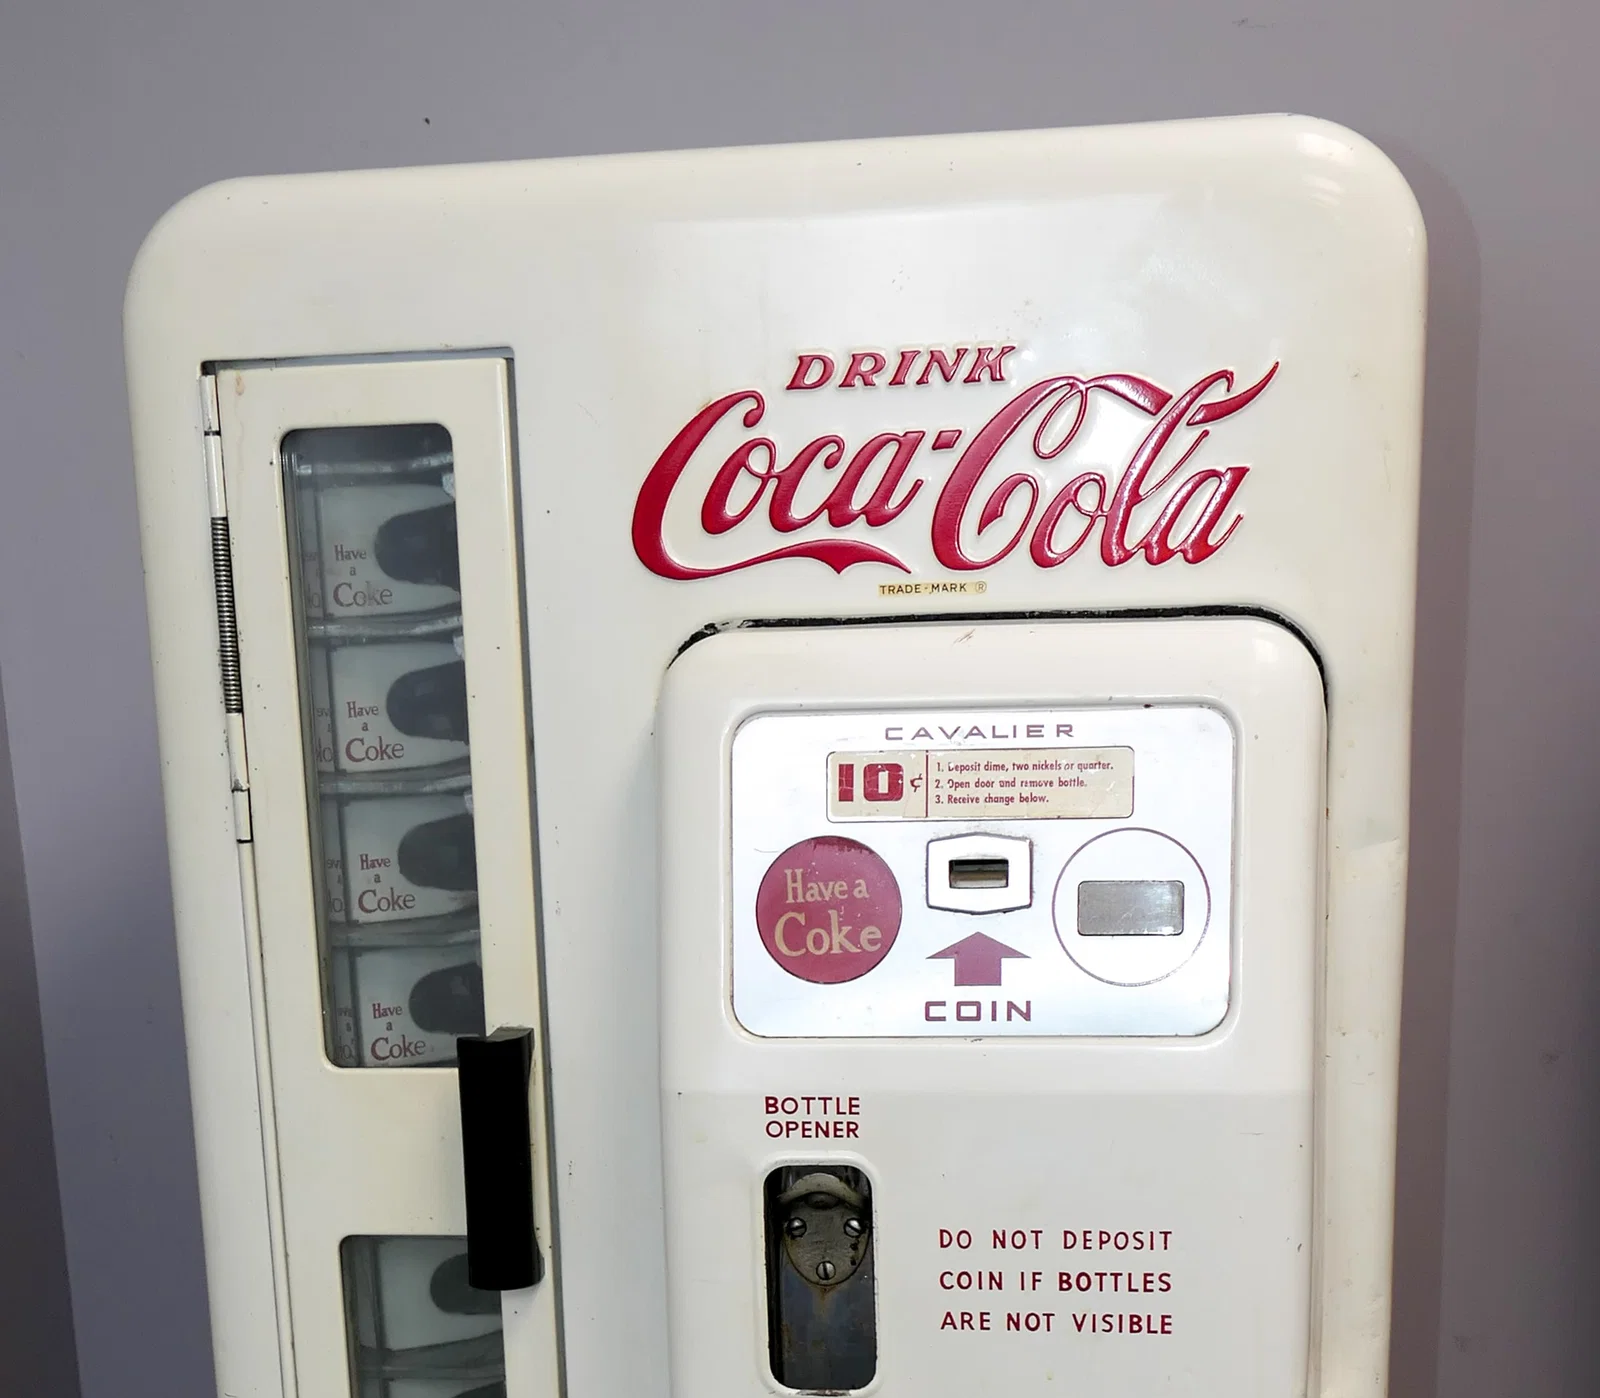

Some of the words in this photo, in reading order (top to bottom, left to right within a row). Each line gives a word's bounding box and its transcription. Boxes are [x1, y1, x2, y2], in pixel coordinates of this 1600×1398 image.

[786, 345, 1017, 391] DRINK
[632, 360, 1280, 581] Coca-Cola
[334, 544, 367, 562] Have
[349, 566, 357, 577] a
[332, 580, 393, 607] Coke
[346, 700, 379, 719] Have
[361, 721, 369, 732] a
[885, 724, 1074, 741] CAVALIER
[345, 736, 405, 763] Coke
[936, 762, 944, 773] 1.
[984, 761, 1009, 772] dime,
[1012, 762, 1030, 771] two
[1032, 760, 1062, 770] nickels
[1064, 763, 1075, 771] or
[1077, 761, 1114, 772] quarter.
[935, 779, 944, 789] 2.
[947, 779, 971, 791] Open
[975, 777, 995, 788] door
[999, 777, 1016, 788] and
[1020, 779, 1054, 788] remove
[1058, 776, 1087, 788] bottle.
[935, 795, 944, 804] 3.
[947, 794, 980, 804] Receive
[984, 793, 1015, 806] change
[1019, 792, 1049, 803] below.
[359, 853, 391, 870] Have
[373, 873, 381, 884] a
[784, 868, 849, 905] Have
[853, 878, 870, 901] a
[358, 887, 416, 914] Coke
[774, 909, 883, 957] Coke
[372, 1002, 403, 1020] Have
[924, 1000, 1032, 1022] COIN
[386, 1021, 393, 1032] a
[370, 1035, 426, 1062] Coke
[764, 1095, 860, 1116] BOTTLE
[765, 1120, 860, 1139] OPENER
[938, 1228, 973, 1250] DO
[992, 1229, 1044, 1250] NOT
[1063, 1230, 1173, 1251] DEPOSIT
[939, 1270, 1003, 1291] COIN
[1020, 1270, 1044, 1292] IF
[1057, 1271, 1173, 1293] BOTTLES
[940, 1311, 991, 1331] ARE
[1006, 1312, 1056, 1332] NOT
[1072, 1313, 1173, 1335] VISIBLE
